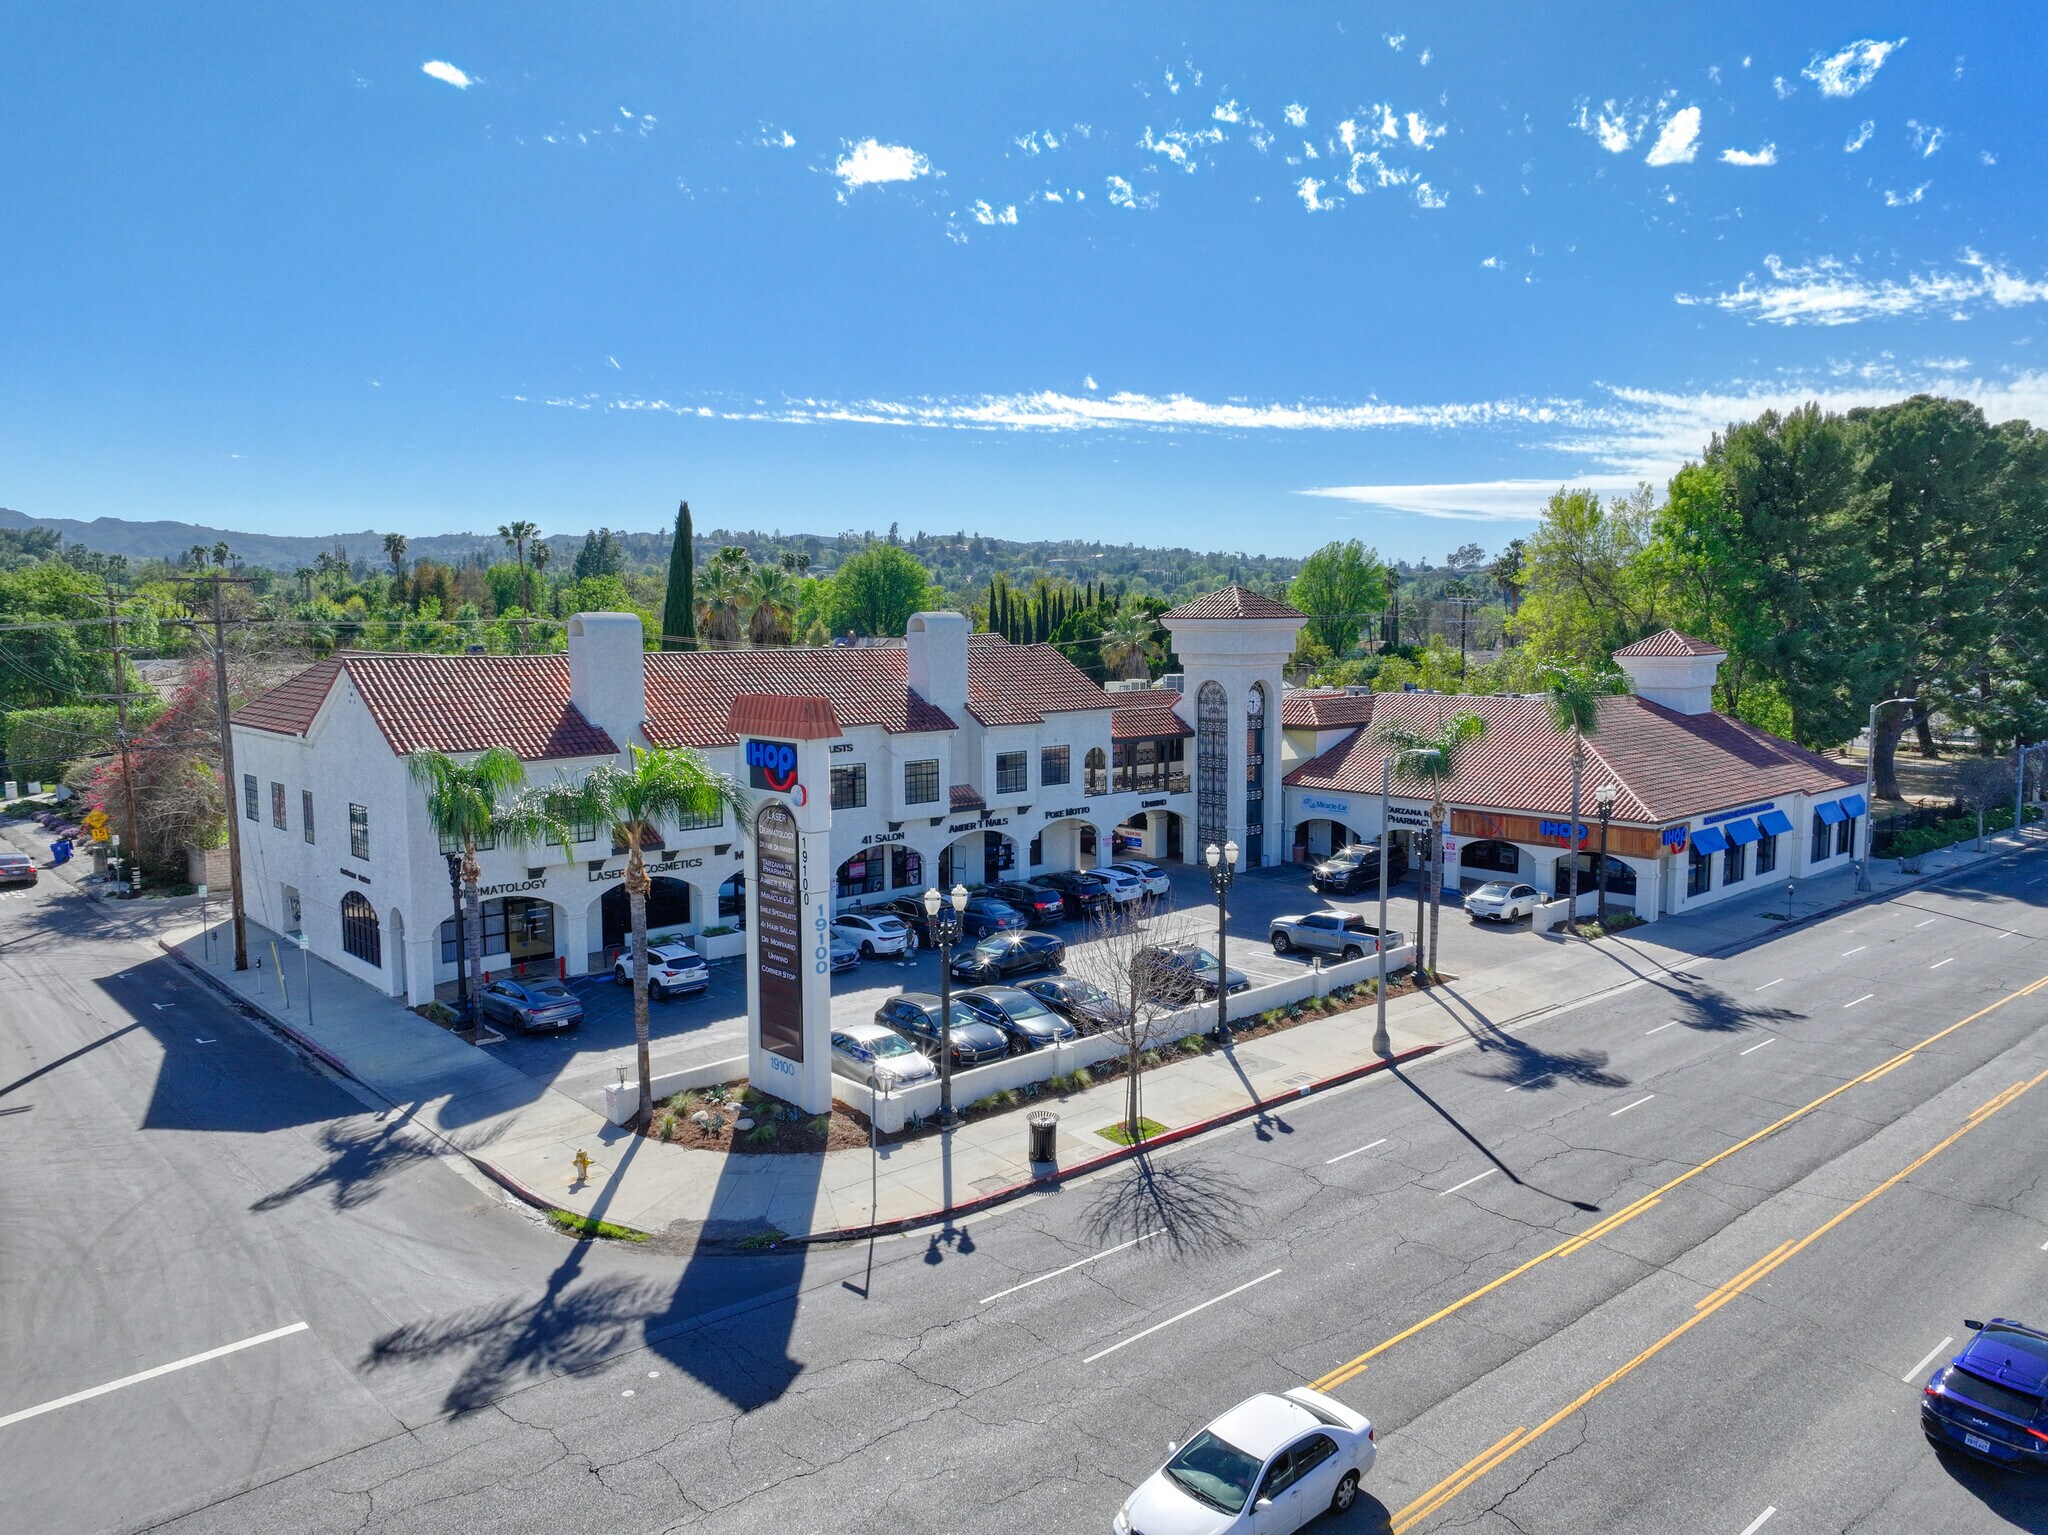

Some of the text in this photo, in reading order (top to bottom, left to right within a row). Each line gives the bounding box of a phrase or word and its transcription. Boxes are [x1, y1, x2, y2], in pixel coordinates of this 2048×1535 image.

[746, 742, 796, 778] IHOP
[767, 810, 787, 822] LASER
[1045, 806, 1090, 819] POKE MOTTO
[759, 825, 795, 840] DERMATOLOGY
[949, 817, 1009, 834] AMBER T NAILS
[94, 829, 105, 837] 15
[861, 832, 905, 844] 41 SALON
[1662, 825, 1688, 846] IHOP
[762, 859, 784, 870] TARZANA
[762, 865, 792, 878] PHARMACY
[760, 877, 778, 887] AMBER
[760, 891, 795, 906] MIRACLE EAR
[760, 905, 797, 921] SMILE SPECIALISTS
[766, 922, 779, 932] HAIR
[779, 925, 797, 936] SALON
[770, 938, 796, 951] MORVARID
[814, 904, 828, 974] 19100
[767, 951, 789, 964] UNWIND
[761, 965, 797, 981] CORNER STOP
[770, 1056, 795, 1076] 19100
